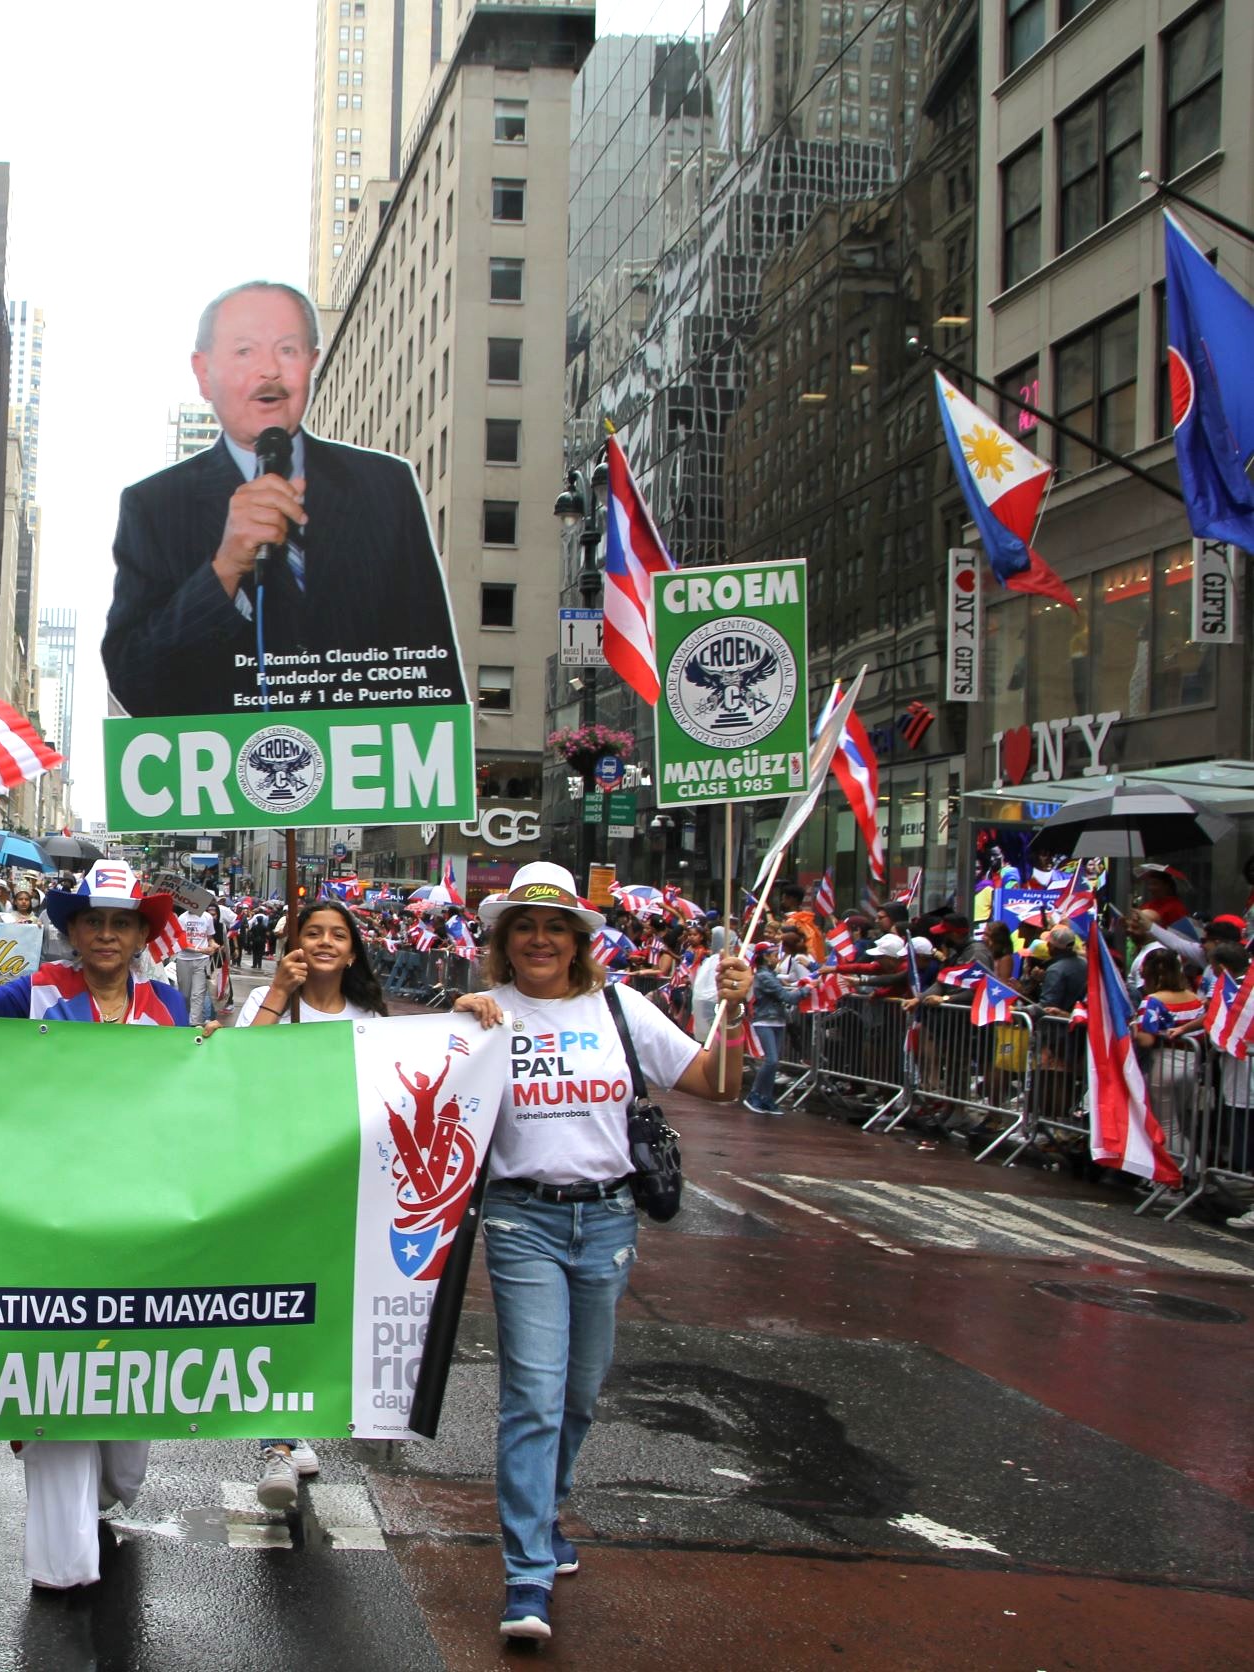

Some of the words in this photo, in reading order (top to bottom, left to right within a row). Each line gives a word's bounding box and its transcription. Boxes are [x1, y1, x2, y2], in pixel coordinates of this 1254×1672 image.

[662, 570, 800, 614] CROEM
[1202, 572, 1227, 635] GIFTS
[715, 620, 755, 632] CENTRO
[234, 655, 258, 668] Dr.
[263, 651, 321, 667] Ramón
[325, 649, 389, 664] Claudio
[393, 646, 448, 661] Tirado
[699, 637, 761, 668] CROEM
[756, 626, 794, 679] RESIDENCIAL
[256, 671, 337, 686] Fundador
[341, 669, 362, 683] de
[367, 665, 428, 682] CROEM
[954, 646, 973, 695] GIFTS
[233, 691, 294, 707] Escuela
[298, 690, 312, 704] #
[317, 690, 326, 703] 1
[332, 688, 353, 702] de
[358, 687, 413, 702] Puerto
[418, 685, 452, 699] Rico
[668, 681, 678, 692] DE
[783, 684, 793, 697] DE
[667, 693, 710, 743] EDUCATIVAS
[711, 702, 788, 748] OPORTUNIDADES
[258, 738, 300, 759] CROEM
[1031, 710, 1122, 781] NY
[664, 750, 786, 785] MAYAGÜEZ
[677, 780, 727, 798] CLASE
[734, 778, 773, 794] 1985
[459, 807, 542, 847] UGG
[524, 885, 561, 898] Cidra
[513, 1079, 627, 1108] MUNDO
[96, 1295, 135, 1324] DE
[145, 1290, 306, 1322] MAYAGUEZ
[372, 1290, 433, 1317] nati
